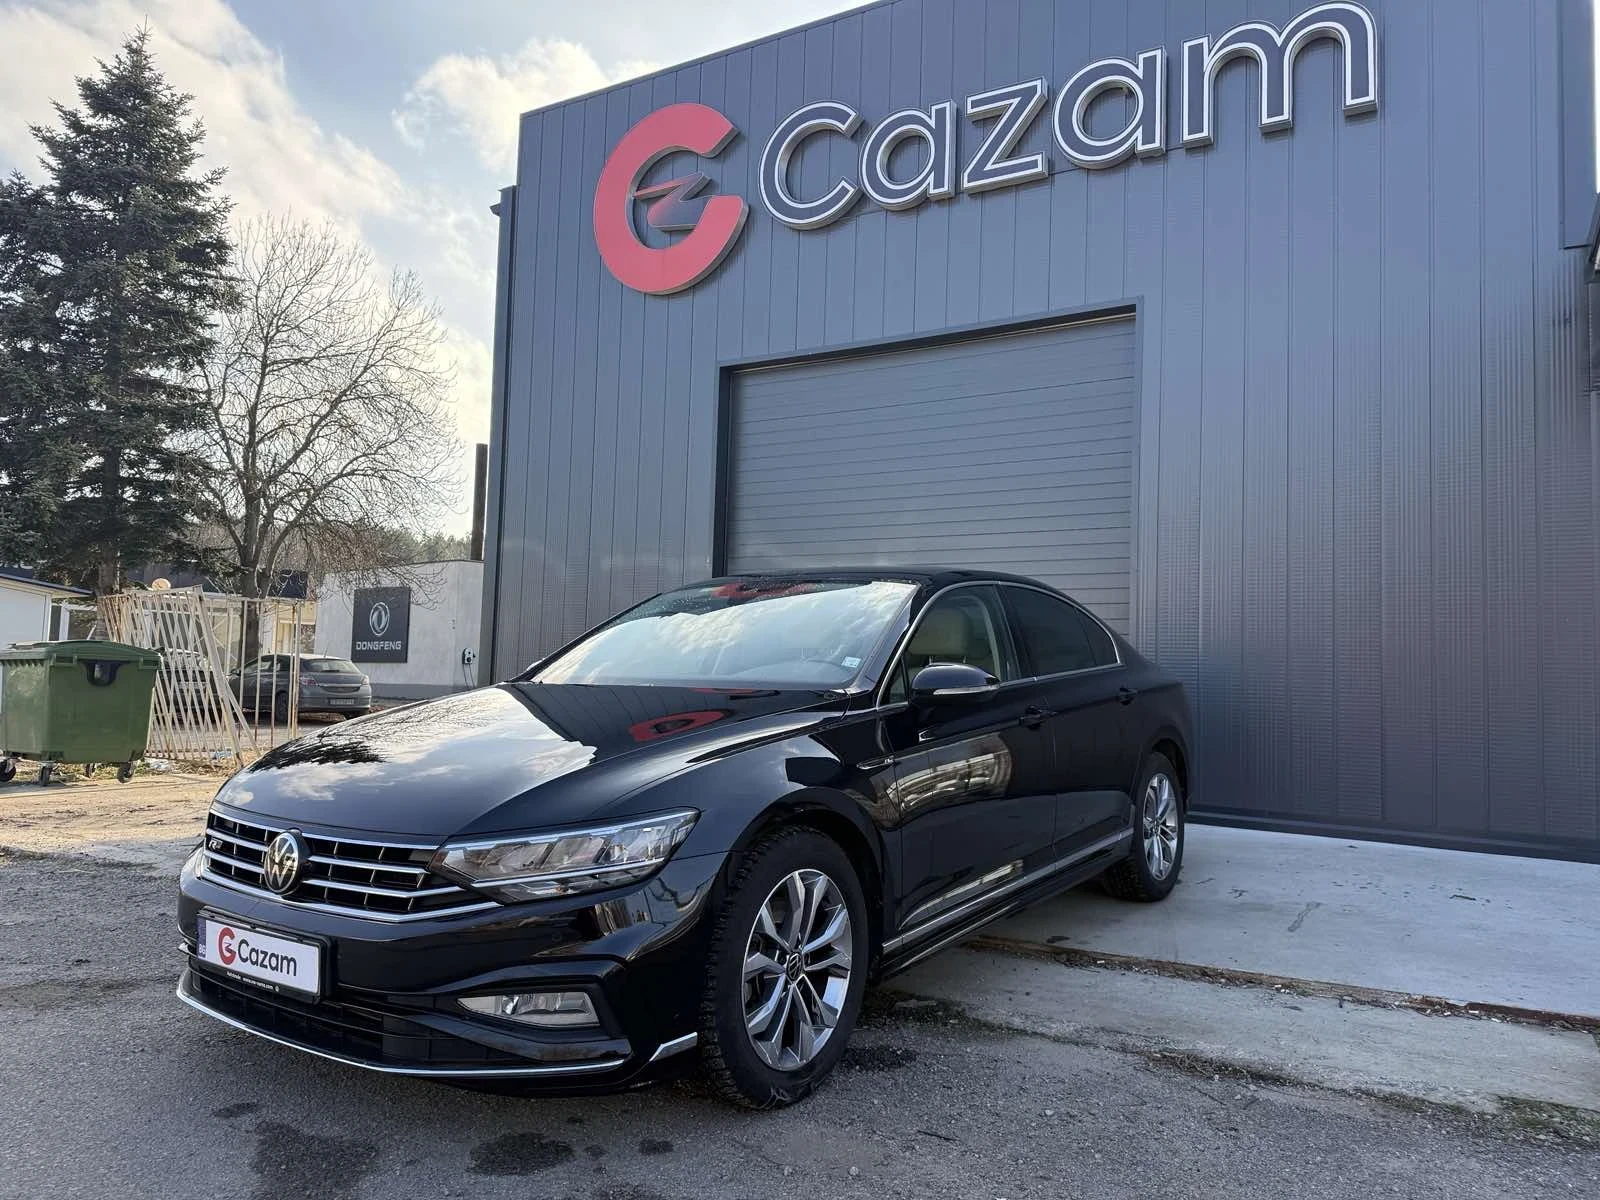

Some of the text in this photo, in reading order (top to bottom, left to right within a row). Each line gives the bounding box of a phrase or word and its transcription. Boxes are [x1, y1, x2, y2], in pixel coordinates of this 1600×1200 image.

[758, 1, 1379, 230] Cazam
[355, 641, 402, 650] DONGFENG
[238, 938, 297, 977] Cazam
